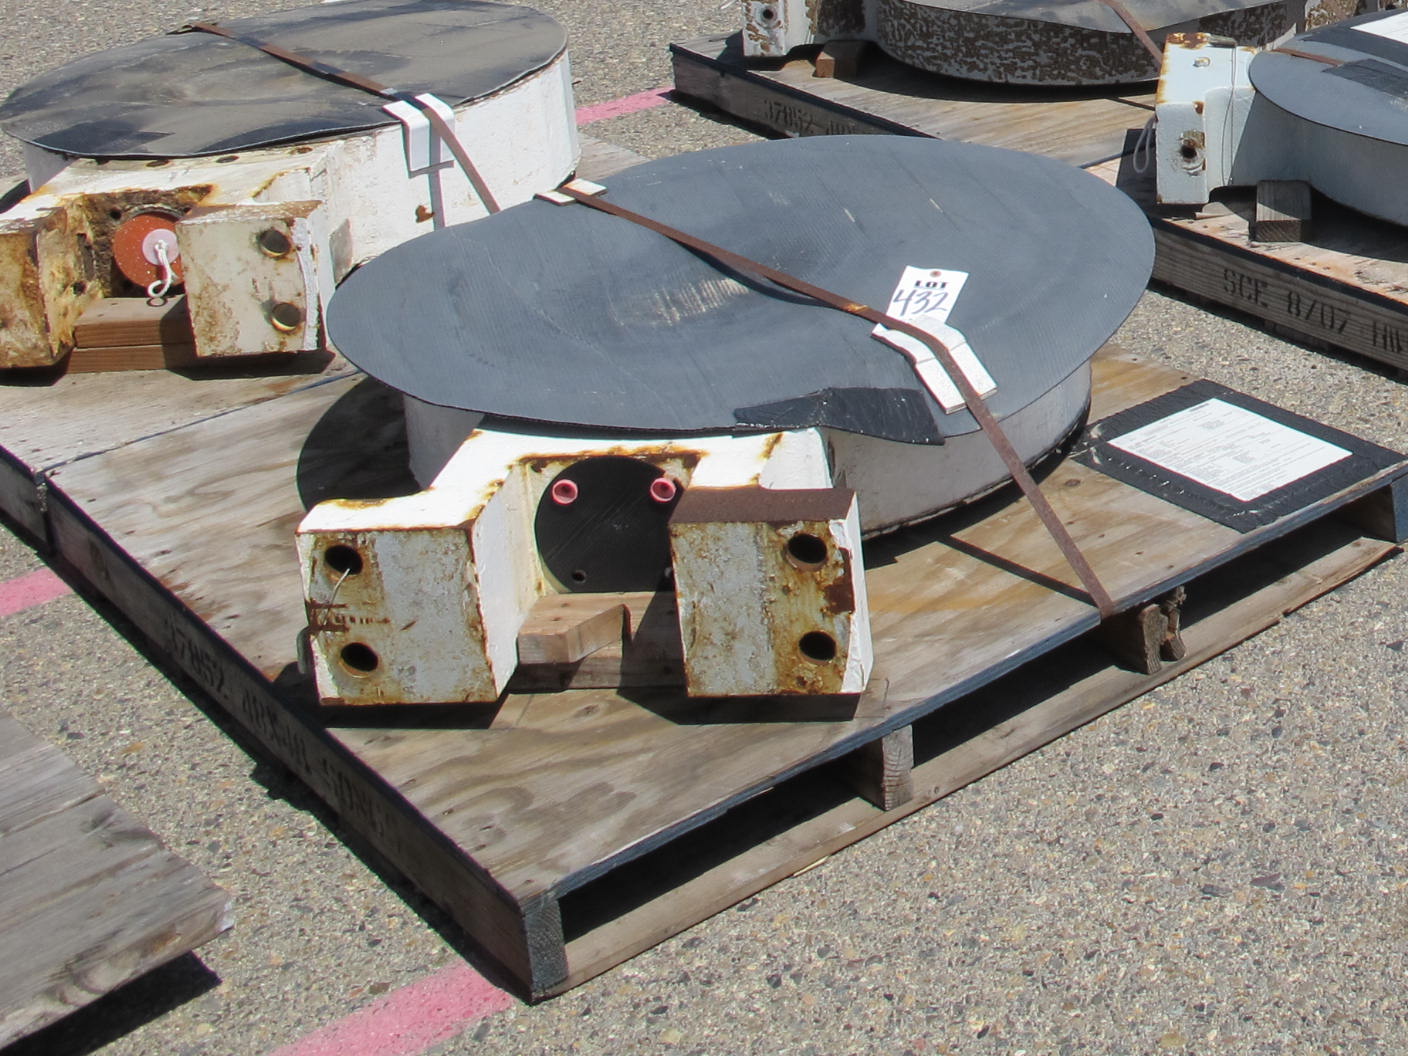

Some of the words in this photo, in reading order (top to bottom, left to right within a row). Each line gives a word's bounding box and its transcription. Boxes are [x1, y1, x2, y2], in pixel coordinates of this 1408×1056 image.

[914, 279, 949, 289] LOT
[893, 289, 949, 317] 432
[1223, 267, 1268, 309] SCE
[1287, 290, 1351, 335] 8/07
